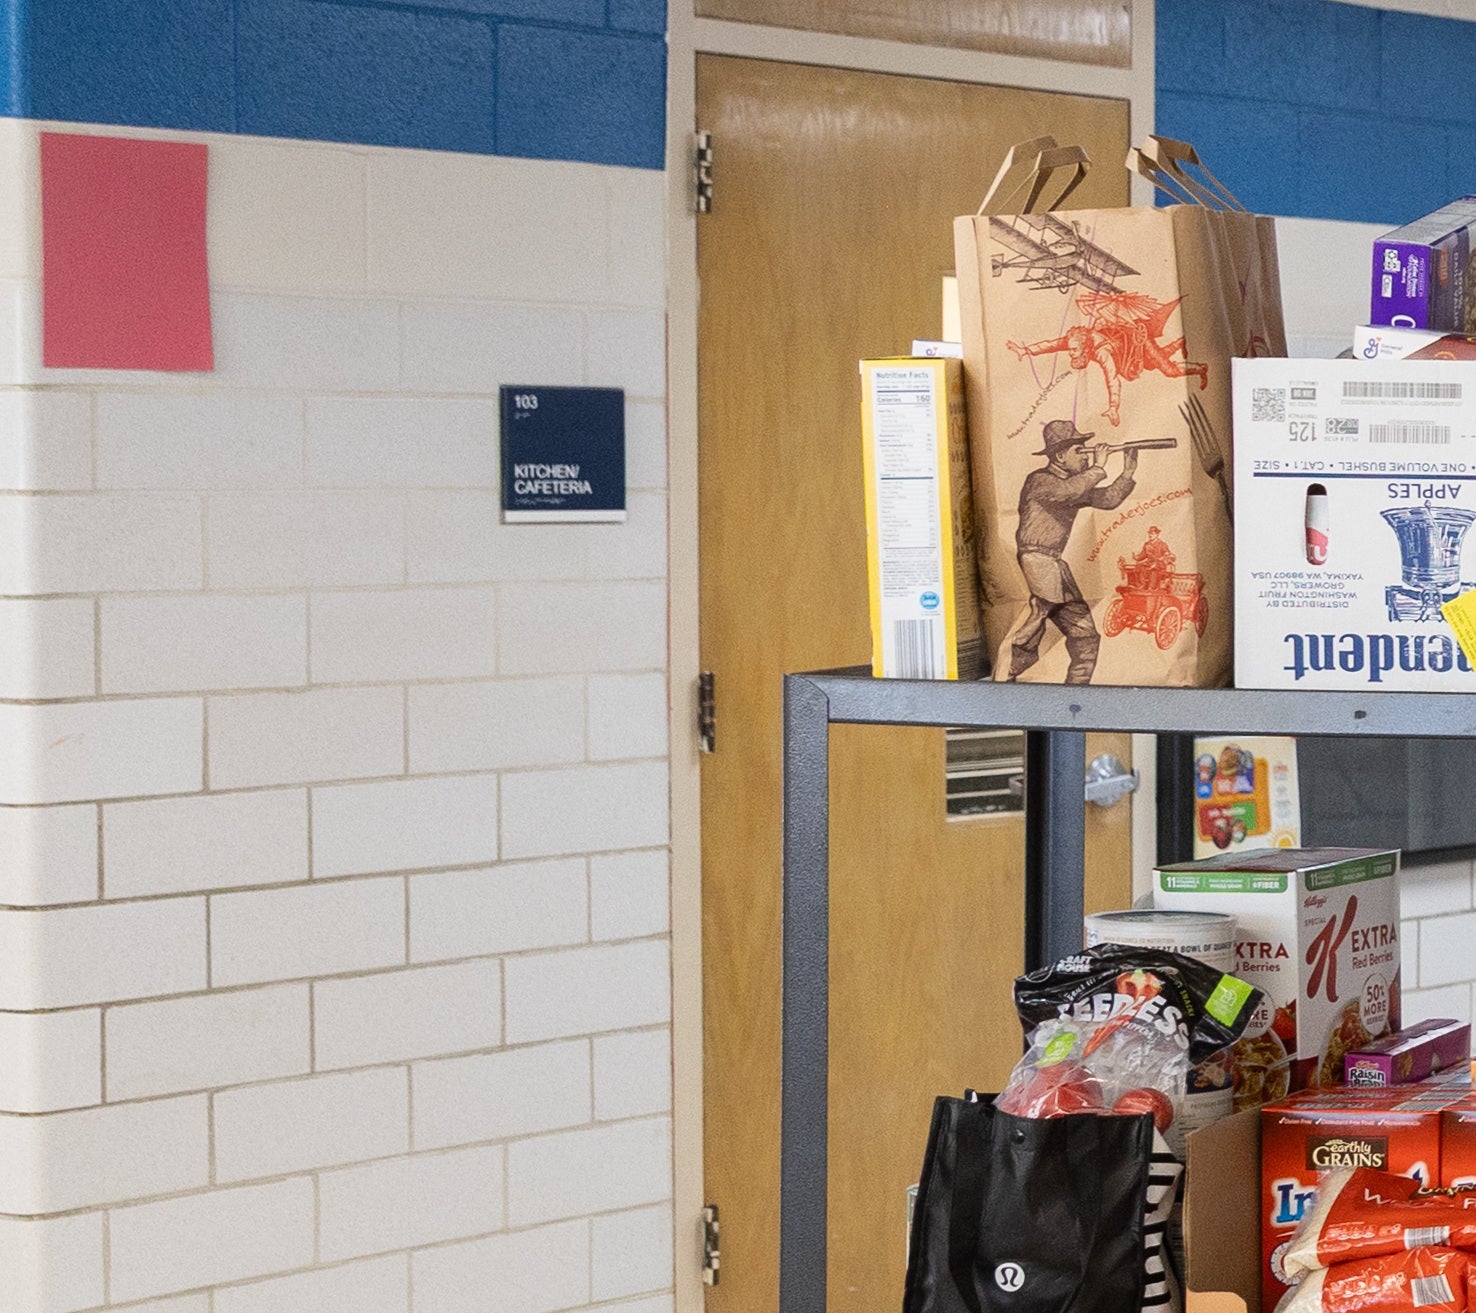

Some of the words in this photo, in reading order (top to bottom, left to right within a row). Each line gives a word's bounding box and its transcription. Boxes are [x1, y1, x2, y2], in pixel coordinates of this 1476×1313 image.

[514, 394, 539, 410] 103
[1290, 422, 1318, 443] 125
[514, 463, 580, 479] KITCHEN/
[1254, 460, 1282, 471] SIZE
[1339, 461, 1388, 472] BUSHEL
[1388, 462, 1438, 473] VOLUME
[1439, 462, 1467, 473] ONE
[514, 479, 593, 495] CAFETERIA
[1387, 483, 1462, 500] APPLES
[1087, 487, 1193, 563] www.traderjoes.com
[1258, 590, 1288, 600] FRUIT
[1289, 590, 1358, 600] WASHINGTON
[1265, 599, 1280, 609] BY
[1281, 599, 1350, 609] DISTRIBUTED
[1351, 922, 1398, 954] EXTRA
[1305, 894, 1359, 1003] K
[1242, 961, 1281, 973] Berries
[1352, 955, 1368, 970] Red
[1368, 950, 1394, 968] Berries
[1363, 1002, 1388, 1017] MORE
[1348, 1068, 1386, 1081] Raisin
[1330, 1140, 1372, 1156] earthly
[1311, 1146, 1385, 1168] GRAINS
